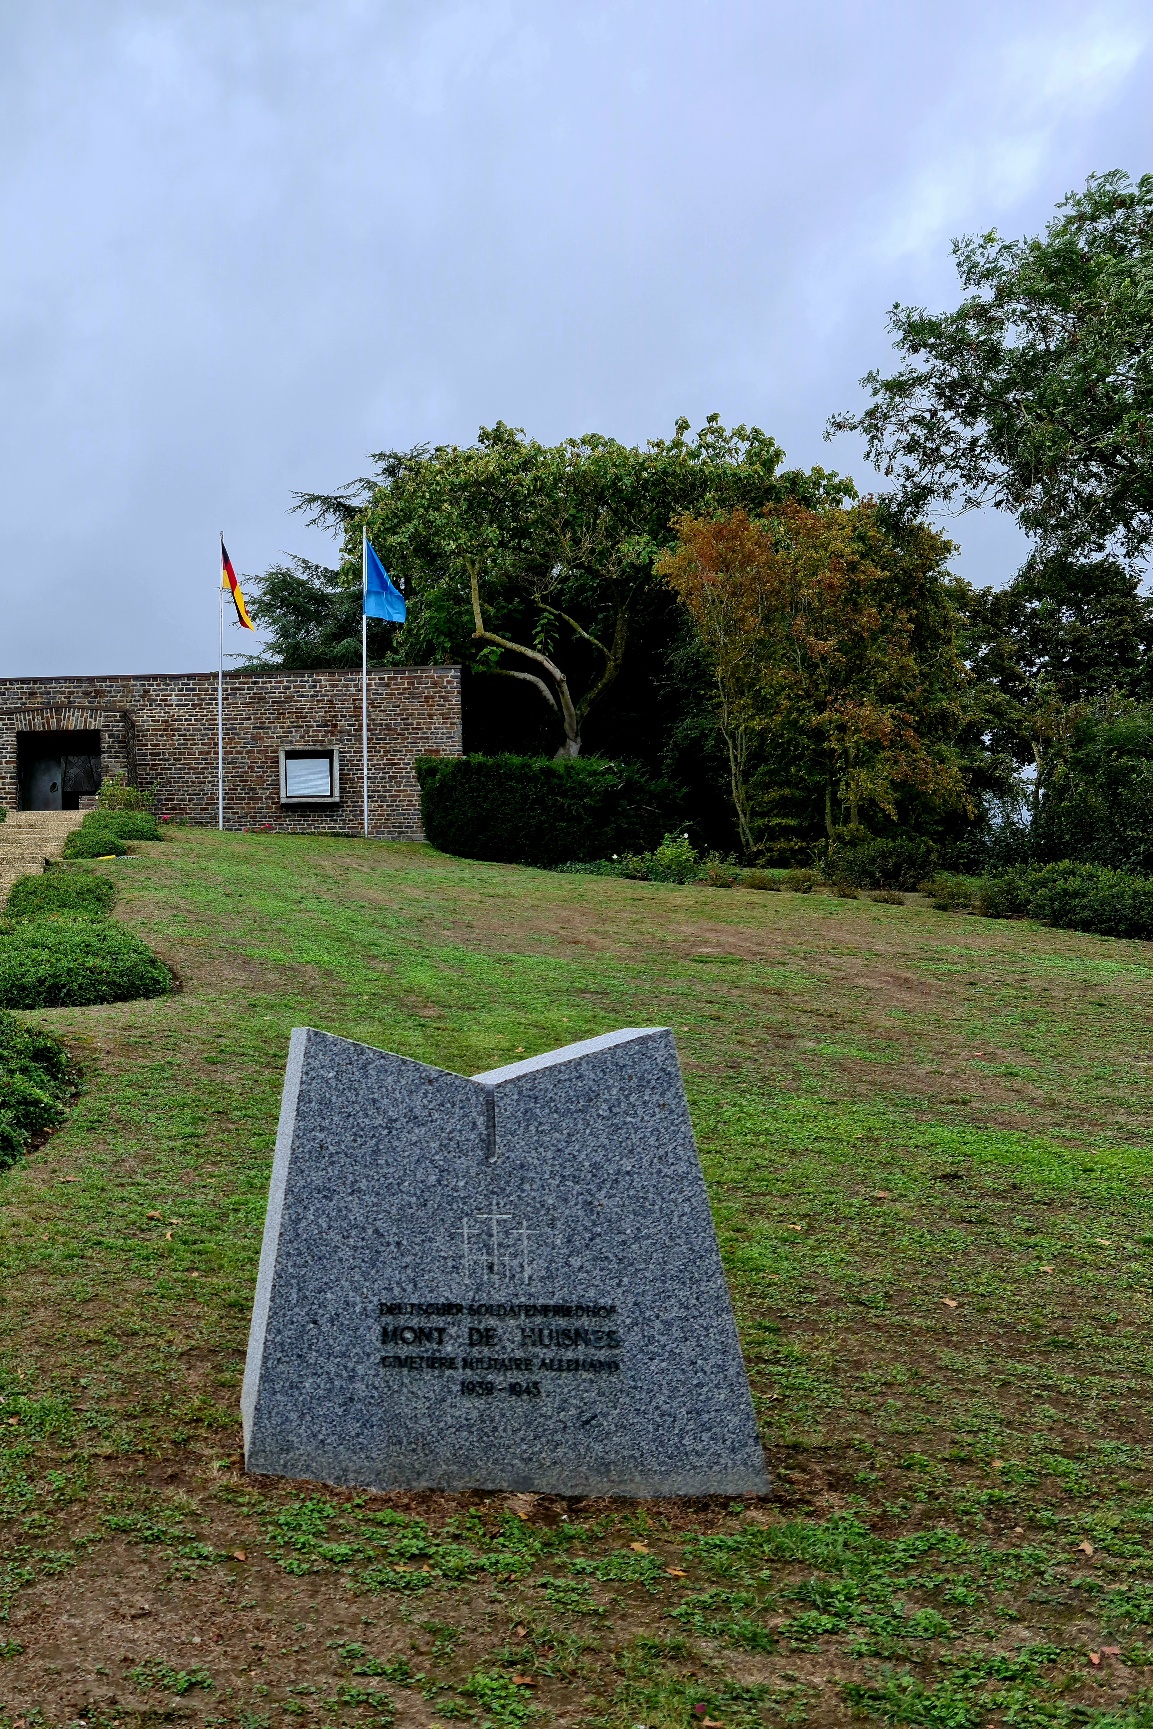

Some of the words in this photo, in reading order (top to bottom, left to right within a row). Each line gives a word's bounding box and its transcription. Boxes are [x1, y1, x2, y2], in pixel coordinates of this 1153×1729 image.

[379, 1302, 464, 1318] DEUTSCHER
[467, 1303, 617, 1318] SOLDATENFRIEDHOF
[381, 1326, 447, 1346] MONT
[467, 1327, 497, 1347] DE
[520, 1327, 621, 1348] HUISNES
[462, 1356, 533, 1372] MILITAIRE
[537, 1358, 620, 1373] ALLEMAND
[508, 1381, 542, 1397] 1945
